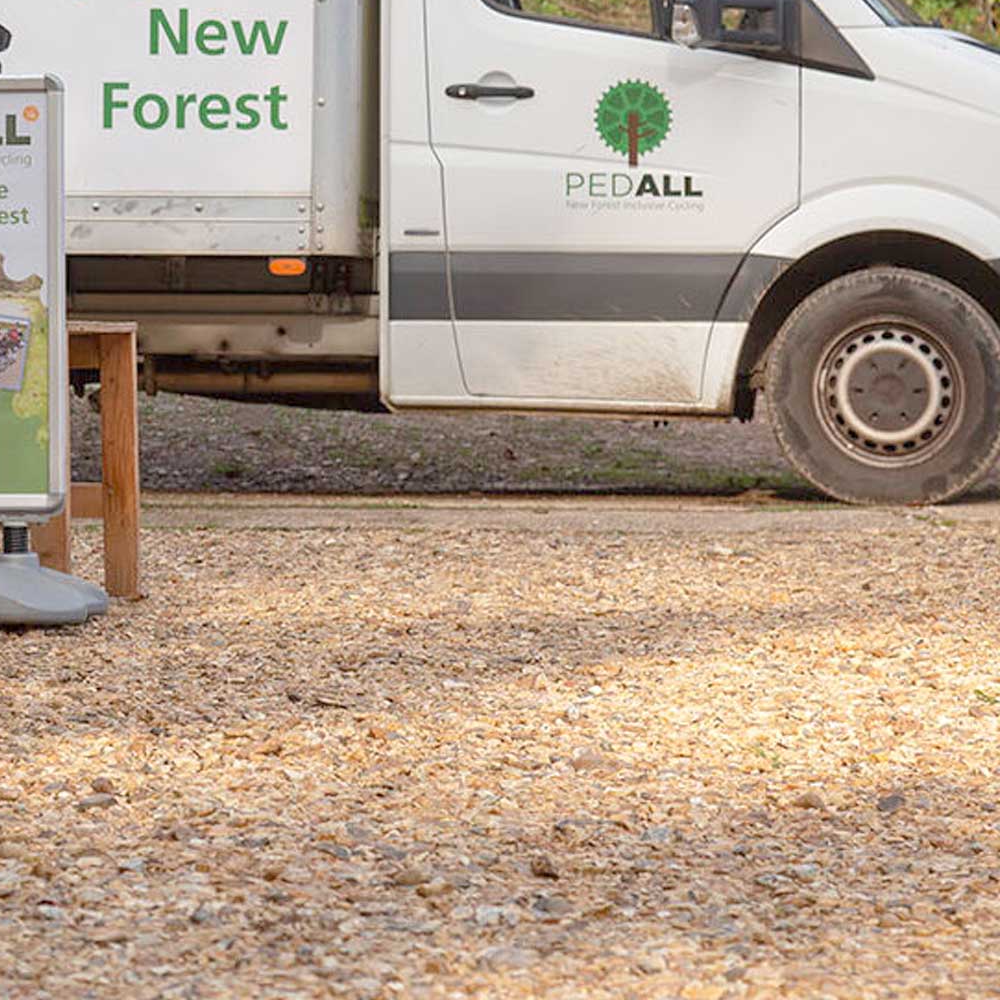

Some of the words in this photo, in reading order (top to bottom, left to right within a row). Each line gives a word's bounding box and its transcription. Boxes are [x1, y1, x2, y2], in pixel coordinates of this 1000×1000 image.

[149, 8, 289, 55] New
[102, 82, 288, 131] Forest
[565, 173, 703, 197] PEDALL
